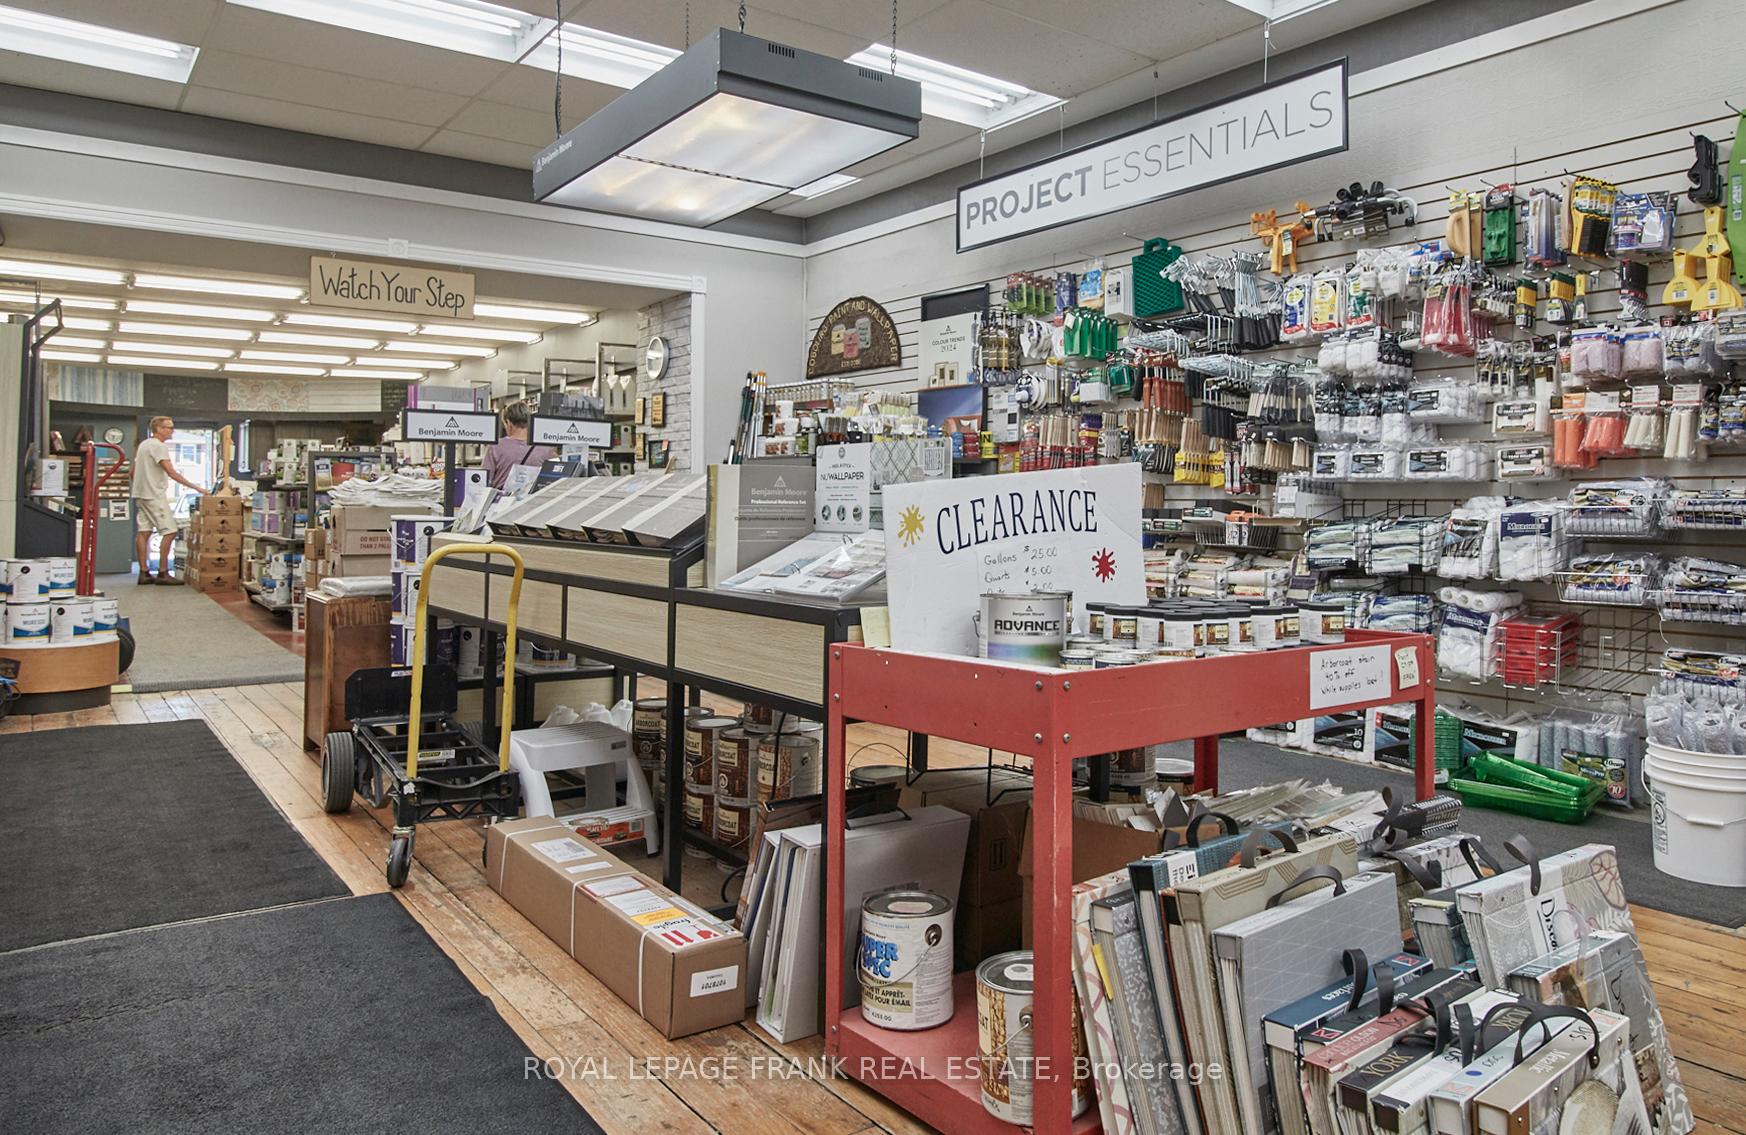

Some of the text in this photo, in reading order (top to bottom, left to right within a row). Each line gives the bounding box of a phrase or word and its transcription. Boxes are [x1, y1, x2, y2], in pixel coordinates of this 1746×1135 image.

[966, 90, 1334, 230] PROJECT ESSENTIALS
[319, 265, 465, 317] Watch Your Step
[827, 302, 850, 325] PAINT
[851, 300, 866, 311] AND
[867, 301, 899, 362] WALLPAPER
[931, 335, 966, 346] COLOUR TRENDS
[418, 427, 484, 438] Benjamin Moore
[543, 432, 577, 442] Benjamin
[751, 487, 808, 497] Benjamin Moore
[936, 489, 1098, 555] CLEARANCE
[983, 553, 1017, 566] Gallons
[994, 619, 1060, 632] ADVANCE
[1612, 784, 1622, 794] 10
[653, 917, 692, 930] fragile
[874, 995, 890, 1005] POUR
[891, 997, 912, 1007] ÉMAIL
[1350, 1026, 1379, 1043] OLSON
[1359, 1050, 1414, 1078] YORK
